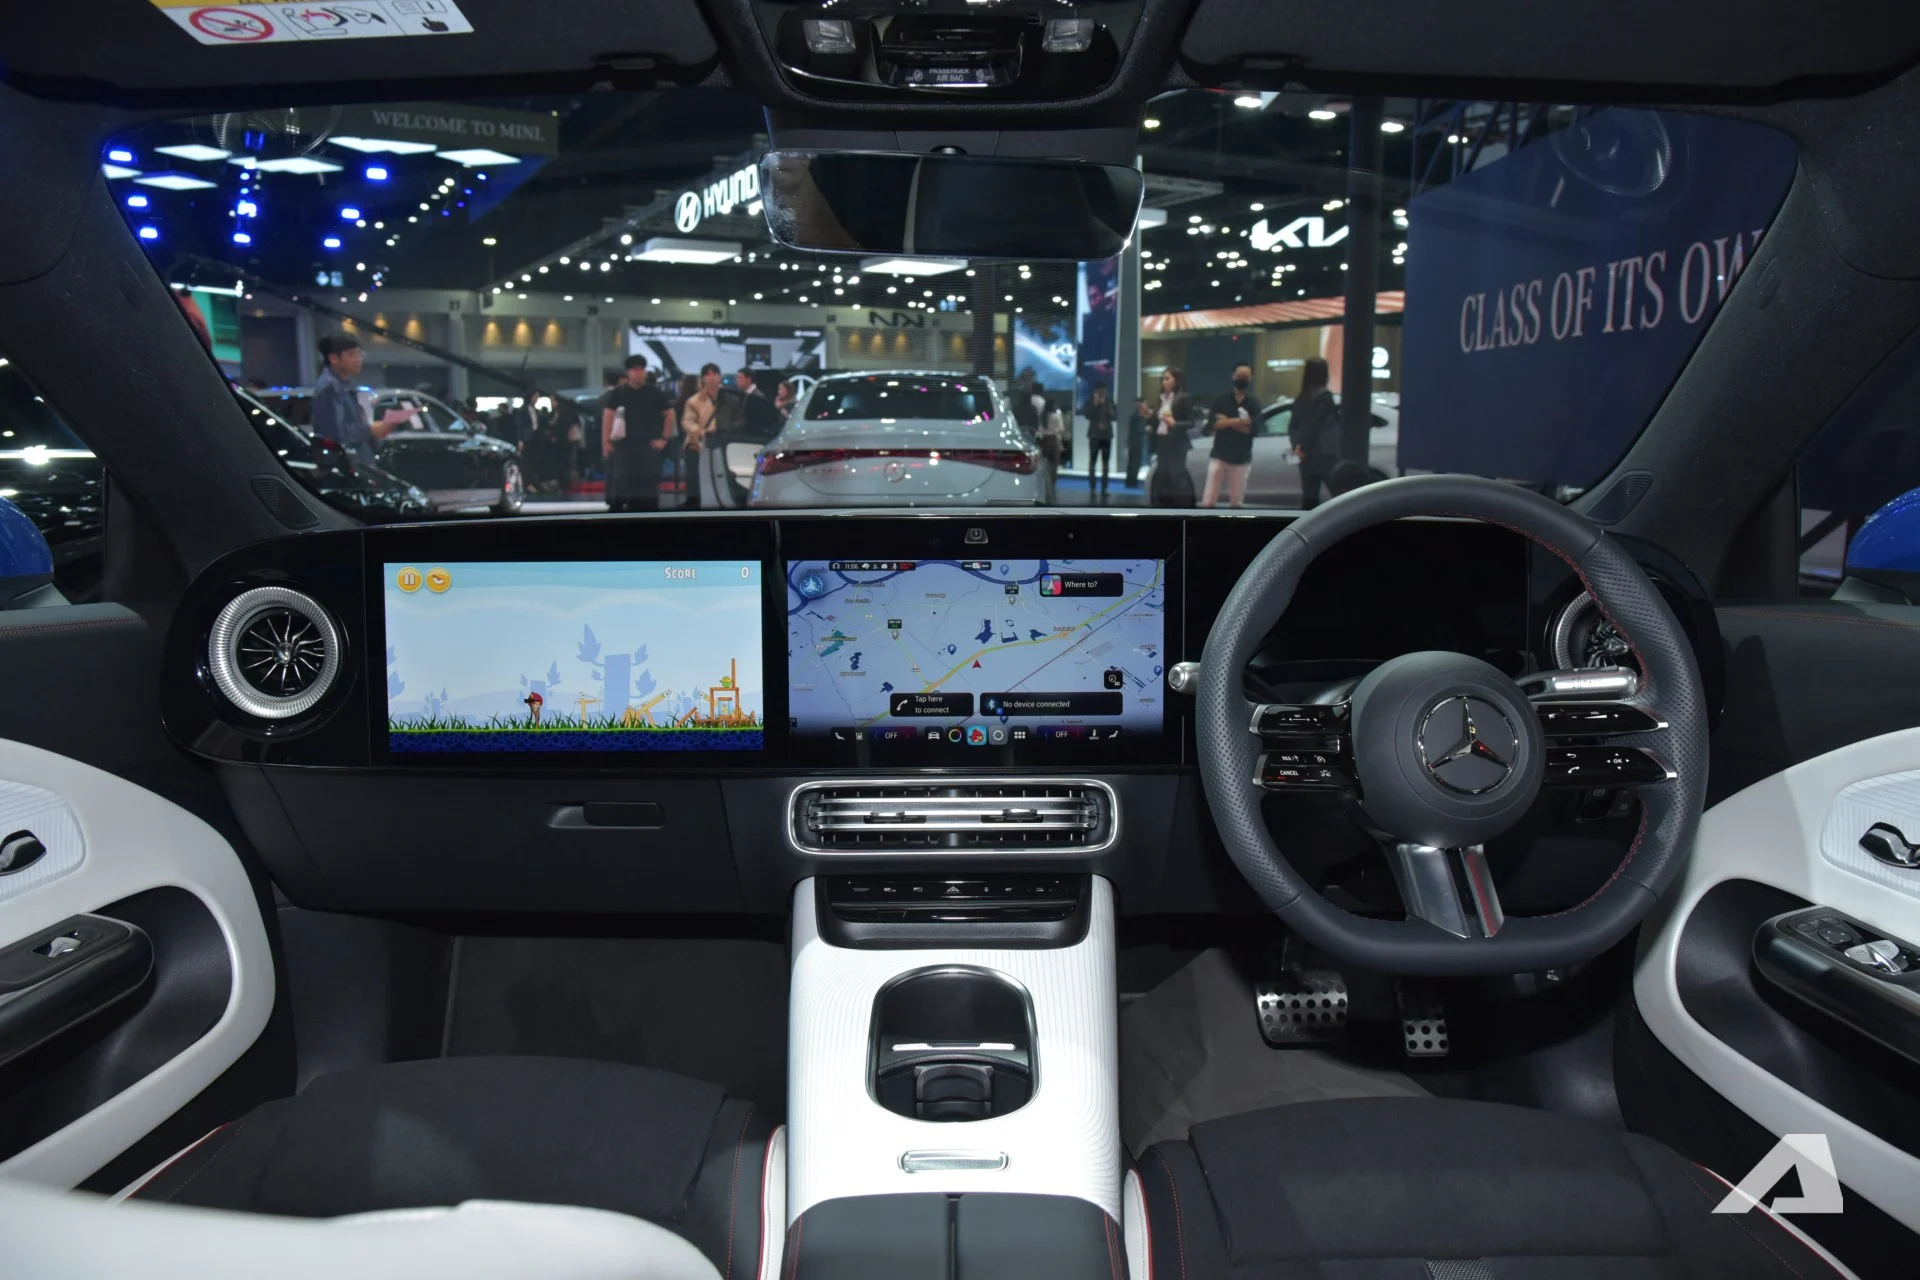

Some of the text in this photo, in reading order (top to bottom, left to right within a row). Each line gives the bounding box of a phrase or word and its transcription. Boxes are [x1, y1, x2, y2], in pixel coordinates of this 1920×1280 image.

[372, 110, 467, 134] WELCOME
[470, 120, 495, 136] TO
[1460, 279, 1542, 353] CLASS
[1552, 266, 1596, 340] OF
[1602, 250, 1667, 333] ITS
[741, 566, 749, 578] 0
[1014, 700, 1035, 708] device
[1036, 700, 1070, 708] connected
